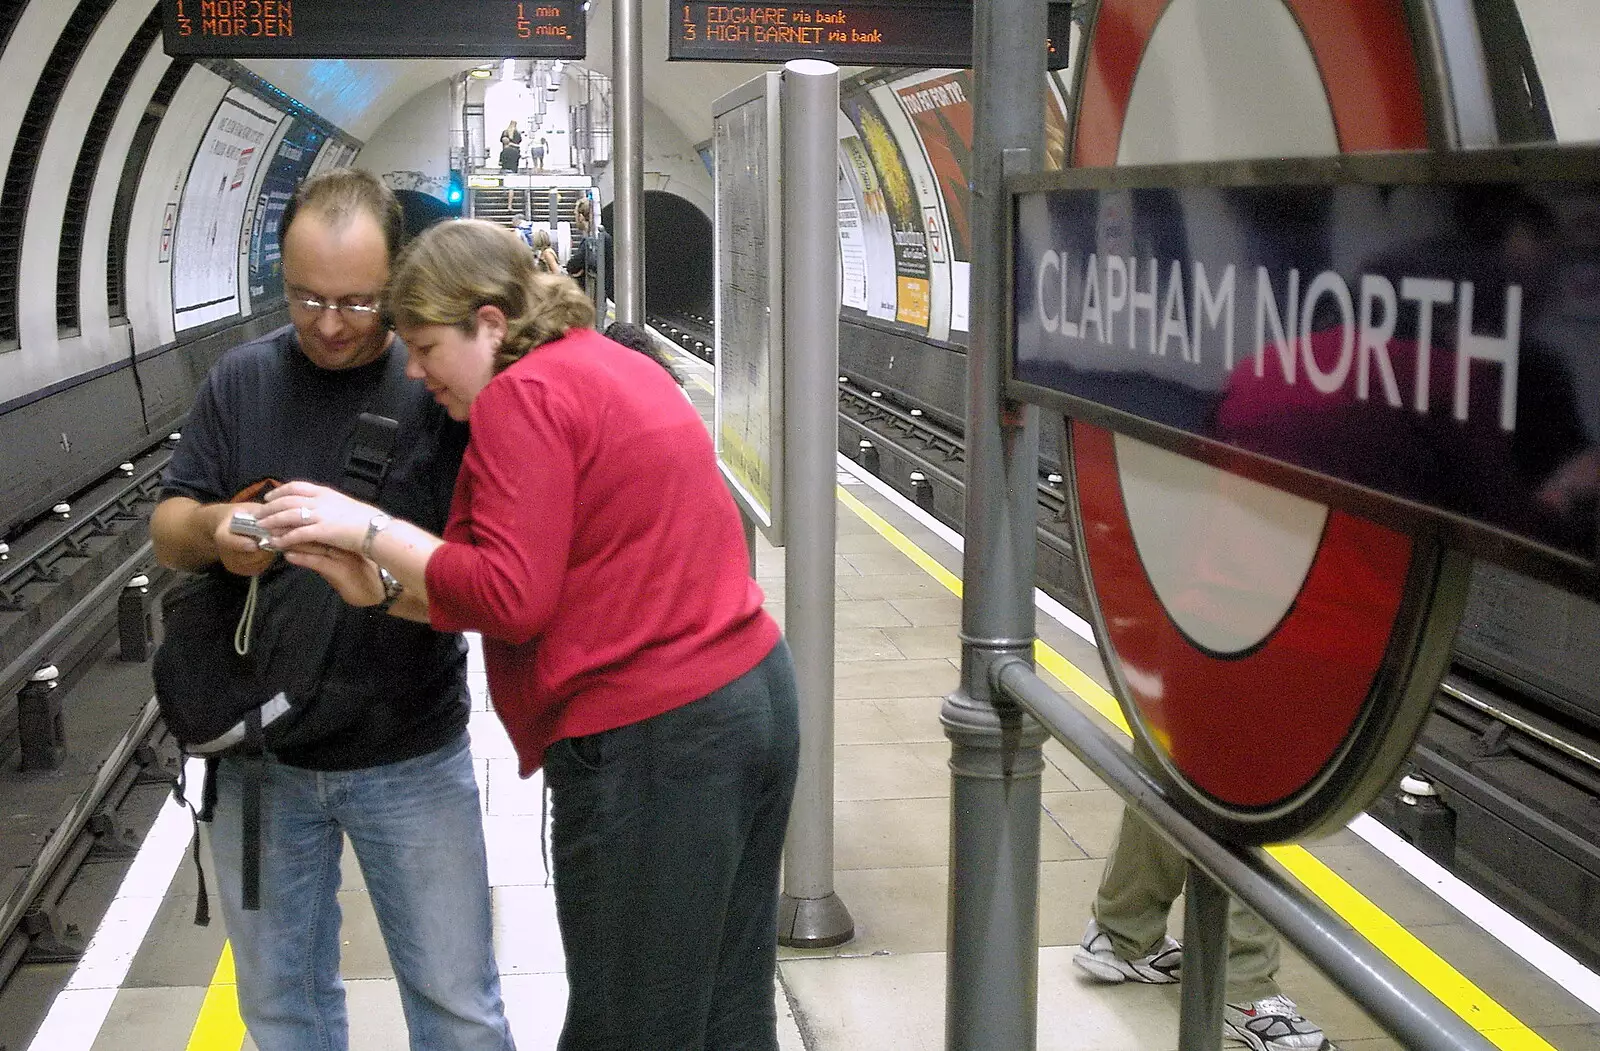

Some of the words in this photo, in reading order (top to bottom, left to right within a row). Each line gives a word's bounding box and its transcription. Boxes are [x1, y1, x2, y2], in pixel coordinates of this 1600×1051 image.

[177, 0, 185, 17] 1
[517, 3, 525, 19] 1
[535, 5, 560, 17] min
[683, 5, 691, 23] 1
[707, 6, 788, 25] EDGWARE
[792, 10, 812, 23] via
[815, 9, 846, 24] bank
[178, 18, 192, 36] 3
[517, 20, 531, 38] 5
[683, 23, 696, 40] 3
[706, 25, 750, 42] HIGH
[754, 25, 825, 44] BARNET
[828, 30, 848, 42] via
[851, 28, 883, 43] bank
[1036, 249, 1236, 371] CLAPHAM
[1254, 265, 1524, 432] NORTH
